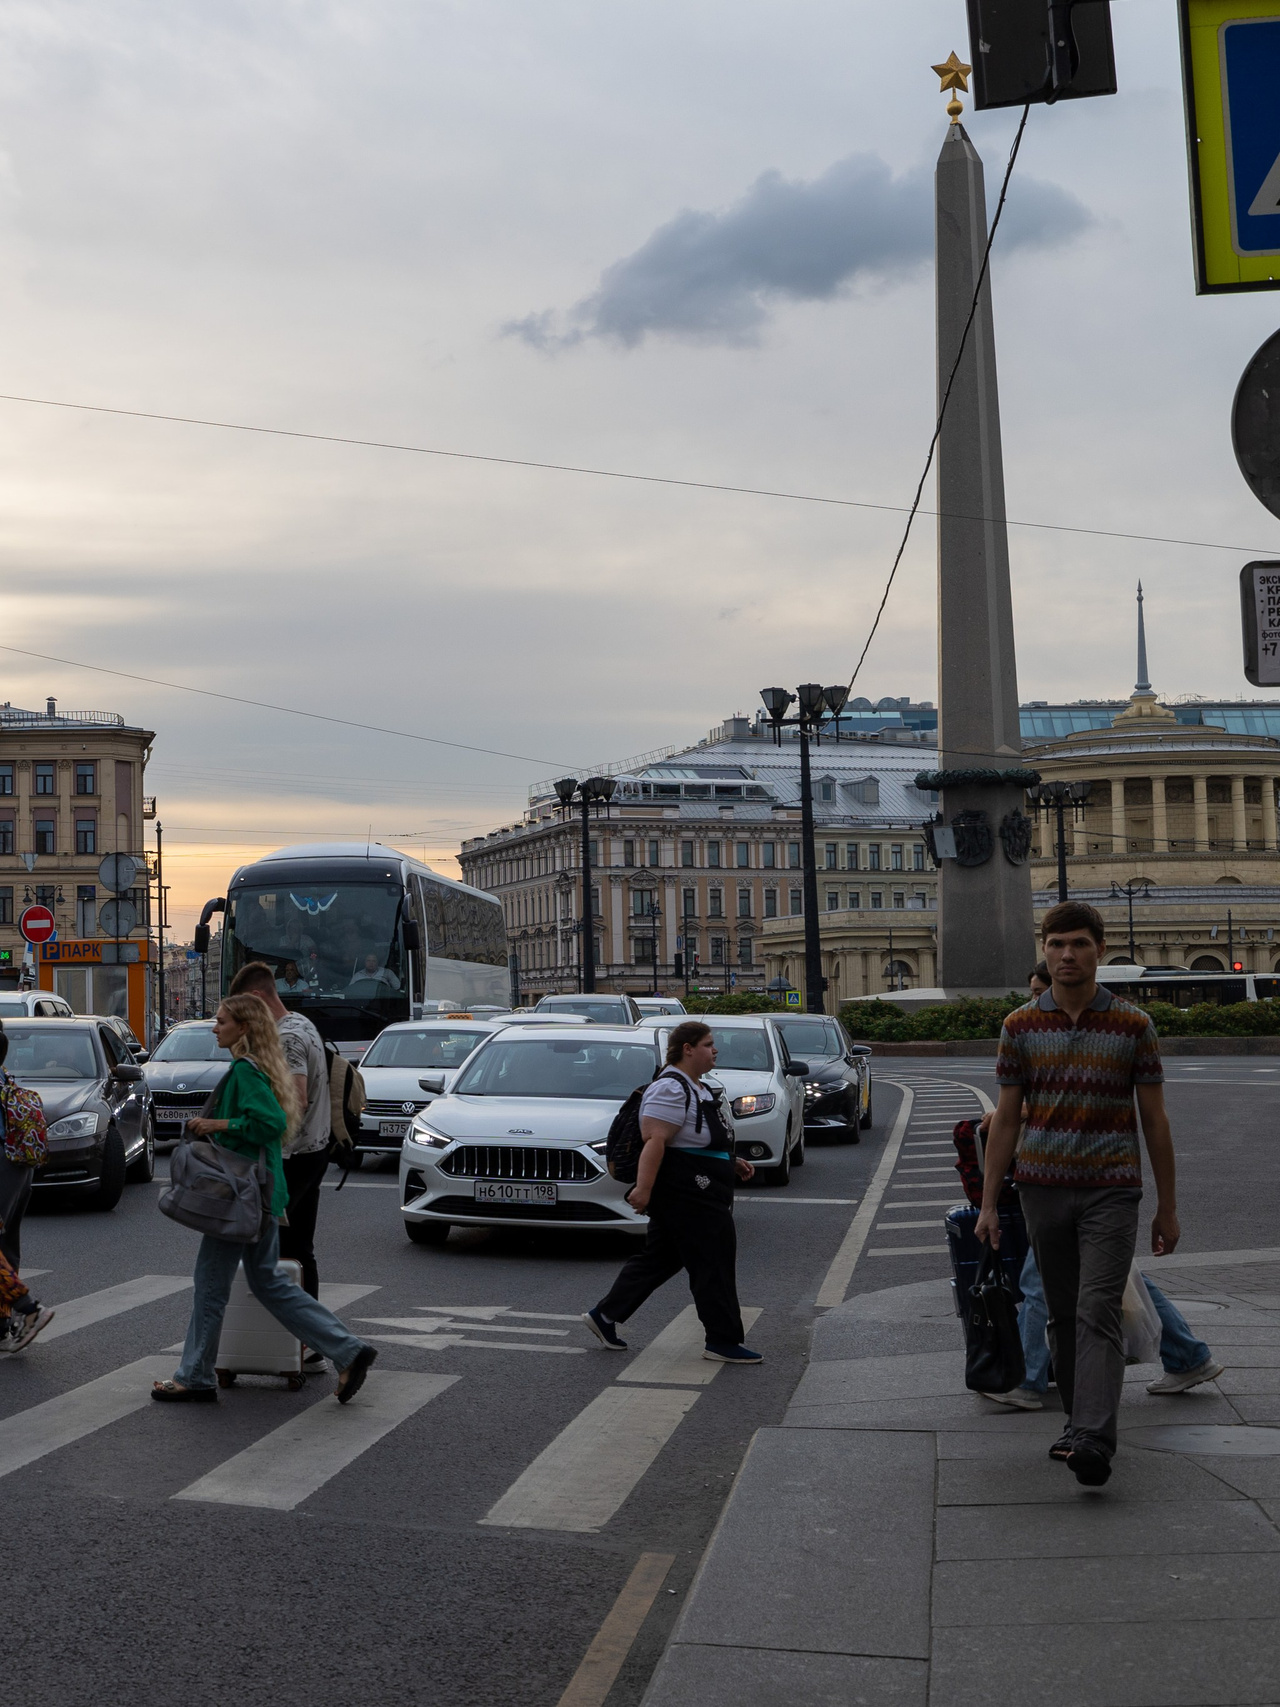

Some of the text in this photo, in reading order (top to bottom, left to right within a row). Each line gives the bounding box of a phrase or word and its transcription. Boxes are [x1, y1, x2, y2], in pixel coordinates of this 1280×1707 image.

[1262, 643, 1278, 656] +7
[382, 1124, 409, 1134] Н375
[479, 1184, 554, 1199] Н610ТТ 198
